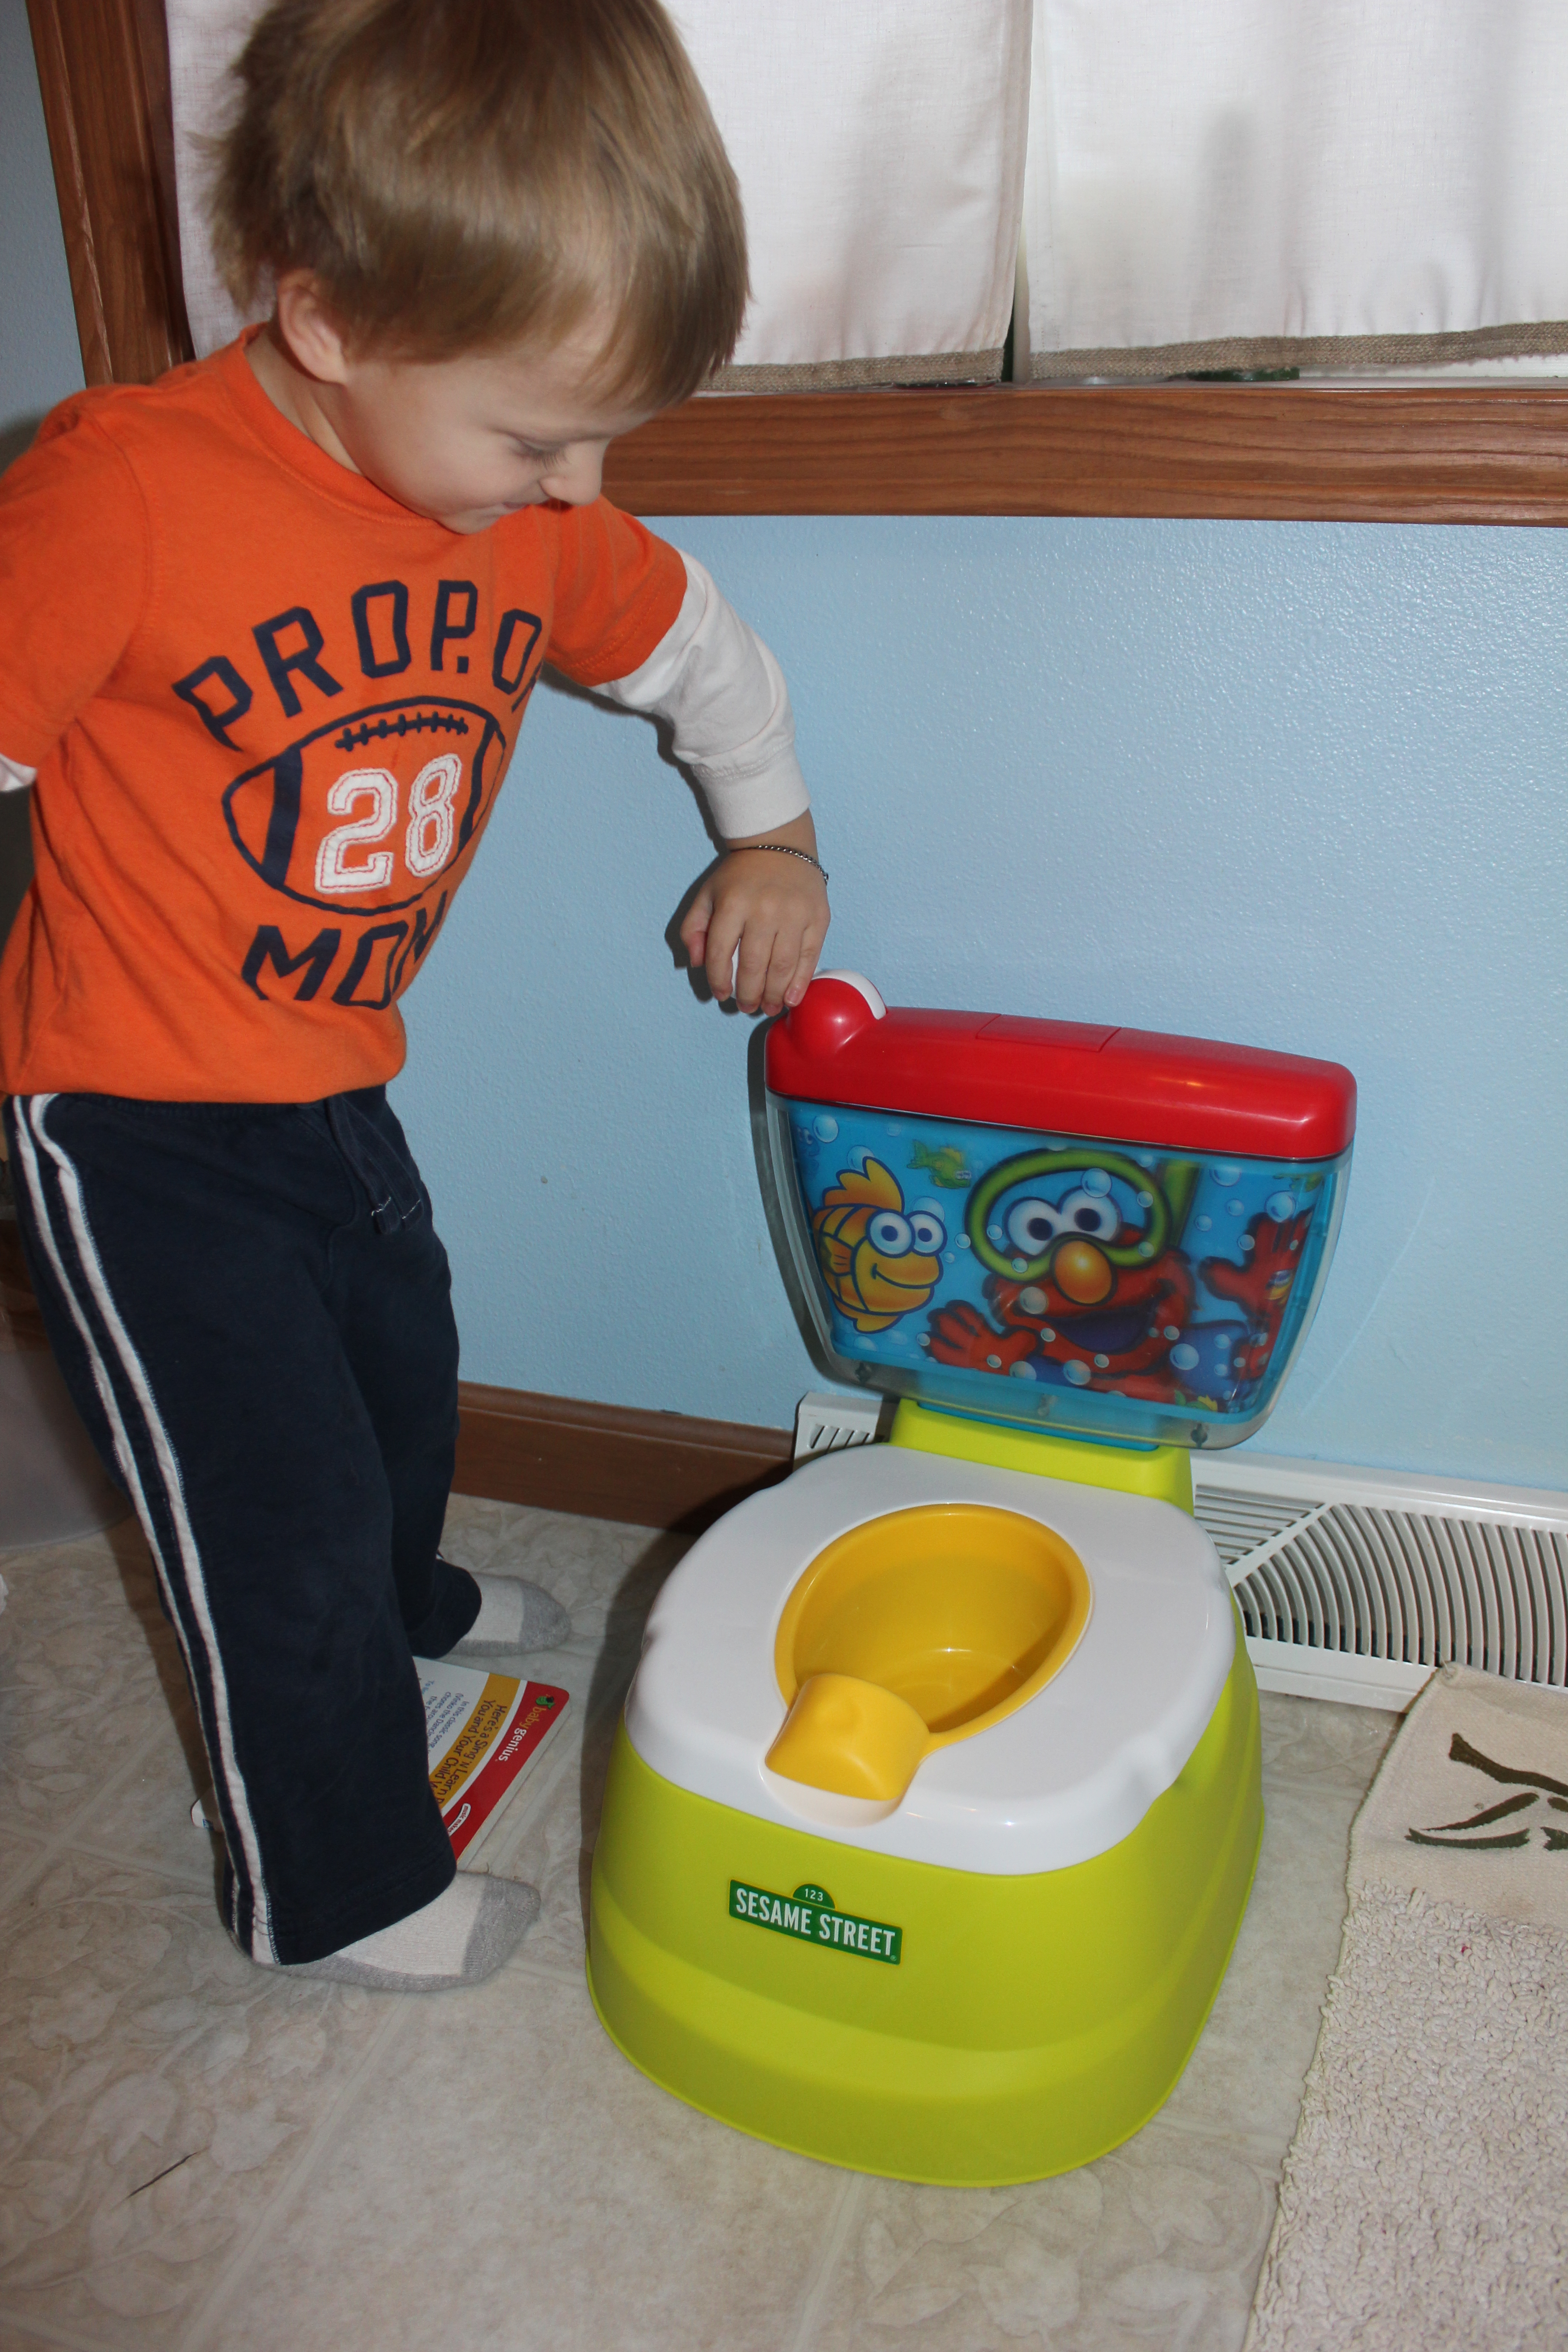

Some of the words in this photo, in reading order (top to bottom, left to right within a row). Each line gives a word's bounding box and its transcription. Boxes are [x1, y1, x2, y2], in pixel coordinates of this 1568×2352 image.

[314, 753, 461, 893] 28
[477, 1700, 496, 1716] You
[483, 1704, 508, 1732] Here's
[519, 1706, 547, 1730] baby
[426, 1719, 444, 1736] Dancin
[439, 1716, 456, 1735] classic
[467, 1716, 484, 1734] and
[453, 1735, 476, 1757] Your
[463, 1739, 489, 1760] Sing
[499, 1728, 527, 1761] genius
[434, 1757, 460, 1779] Child
[436, 1768, 468, 1795] Learn
[804, 1888, 823, 1901] 123
[736, 1888, 812, 1935] SESAME
[818, 1914, 896, 1956] STREET
